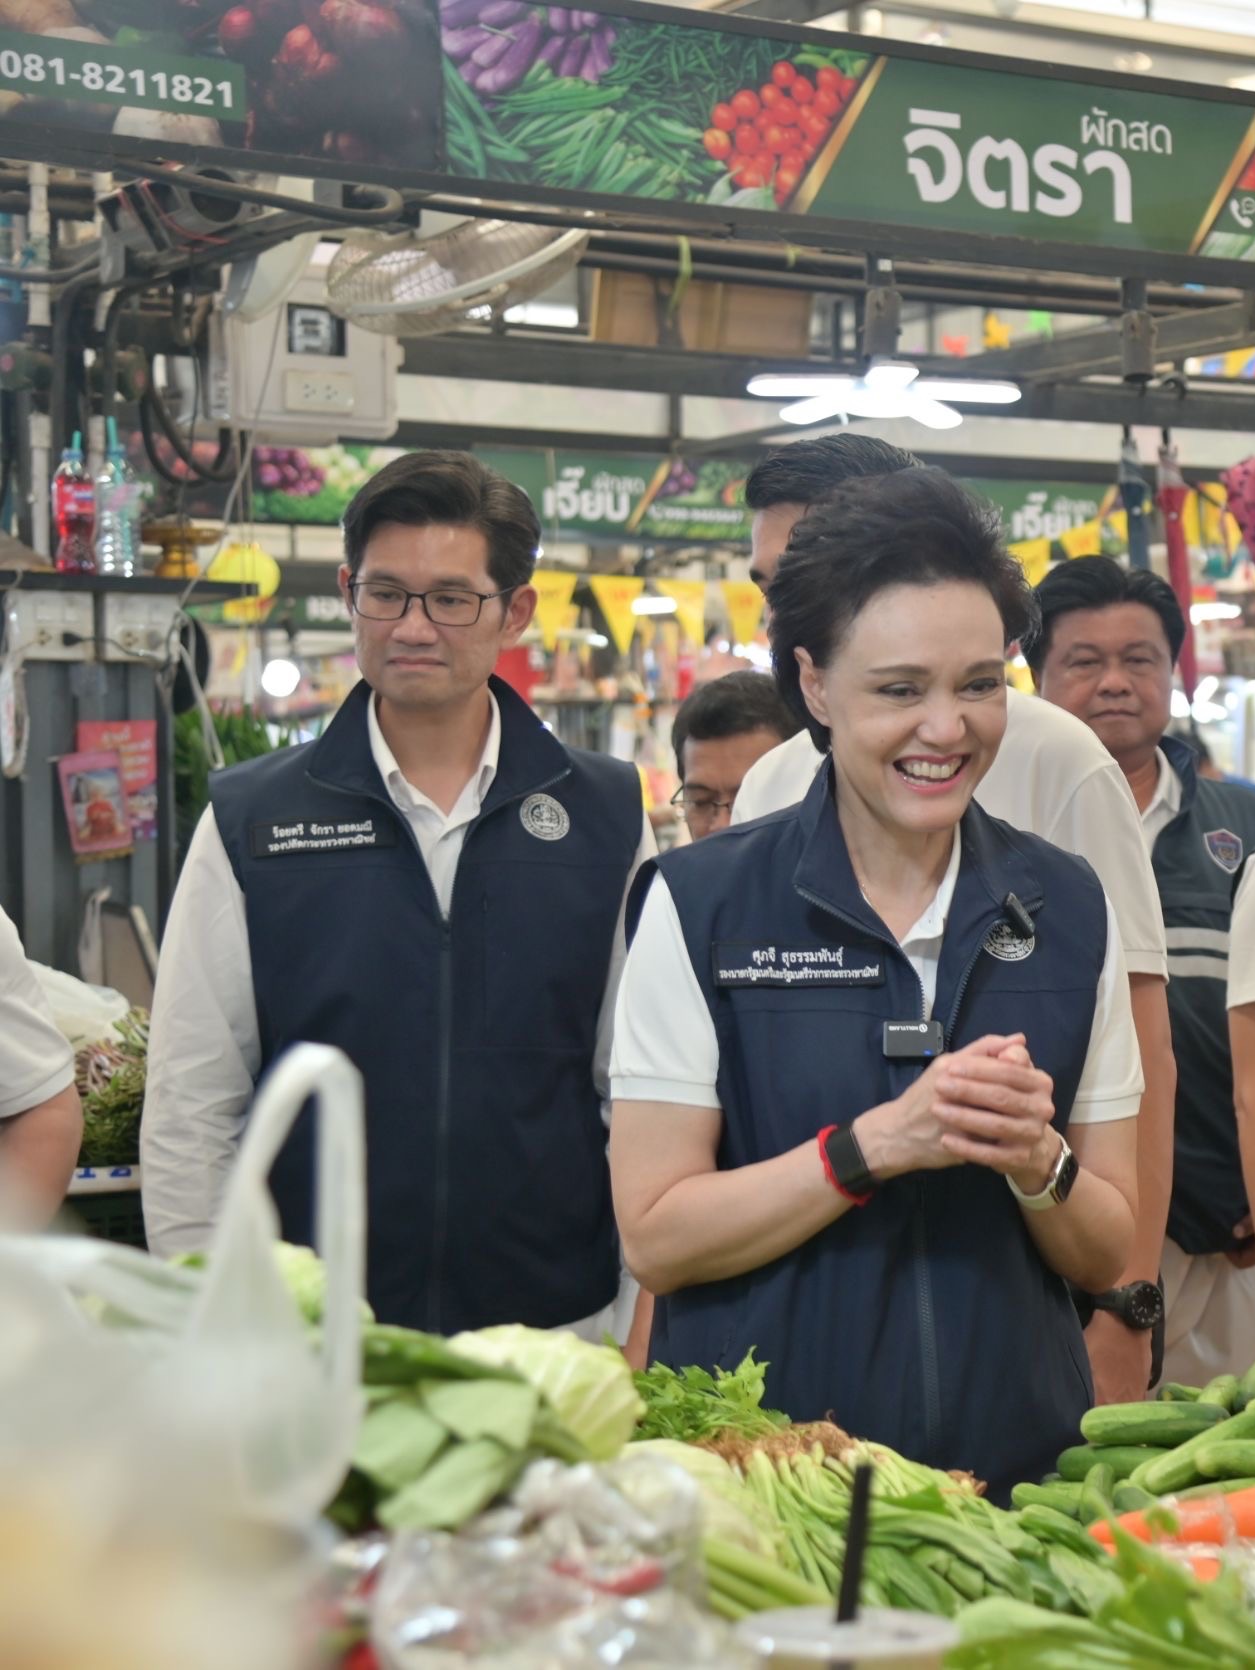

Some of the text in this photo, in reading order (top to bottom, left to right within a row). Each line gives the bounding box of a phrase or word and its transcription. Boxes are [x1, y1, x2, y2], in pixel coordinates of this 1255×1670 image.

[0, 50, 232, 108] 081-8211821
[1081, 106, 1173, 155] ผักสด
[903, 107, 1133, 224] จิตรา
[752, 946, 845, 968] ศุภจี สุธรรมพันธุ์
